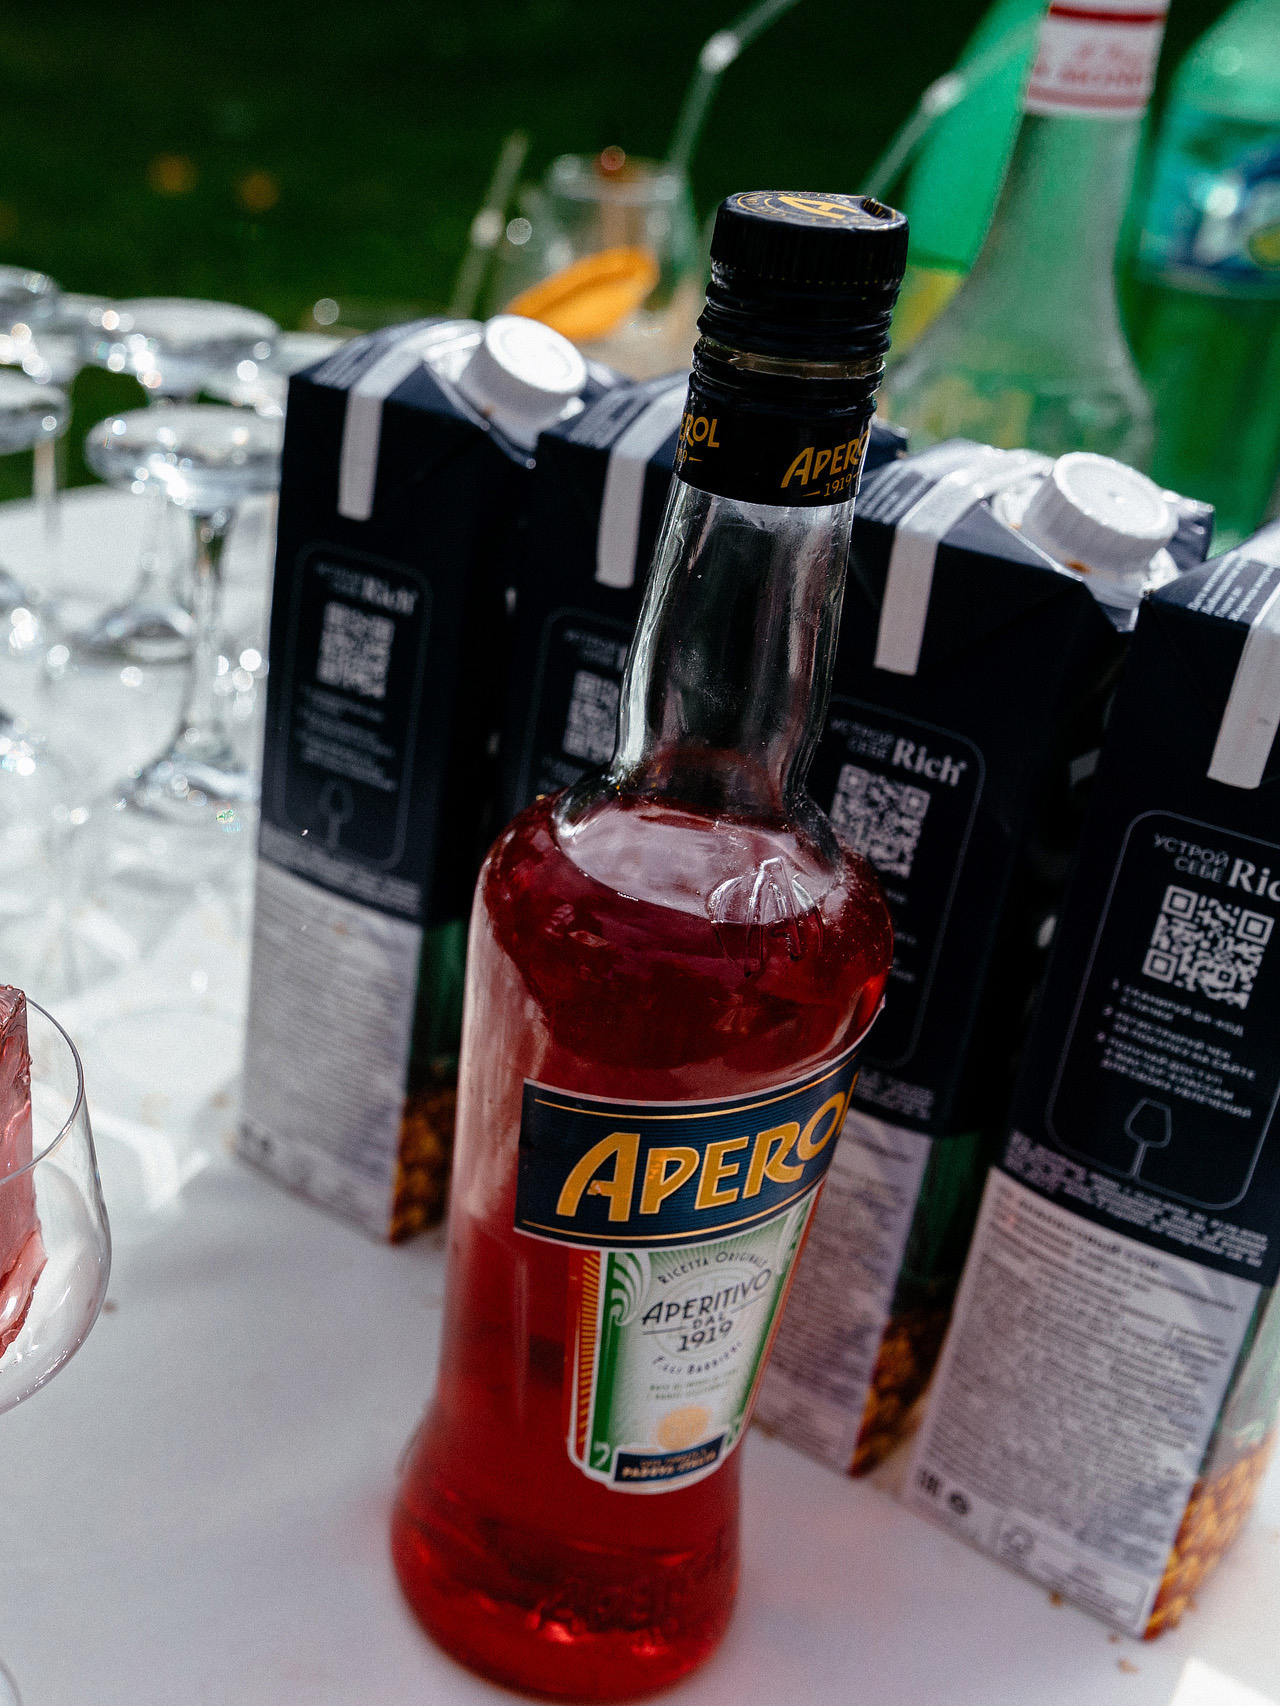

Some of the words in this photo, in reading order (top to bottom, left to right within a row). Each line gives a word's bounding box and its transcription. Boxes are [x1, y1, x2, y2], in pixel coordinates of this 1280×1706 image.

[823, 472, 852, 497] 1919
[641, 1268, 772, 1326] APERITIVO
[692, 1311, 725, 1330] DAL
[677, 1319, 733, 1353] 1919
